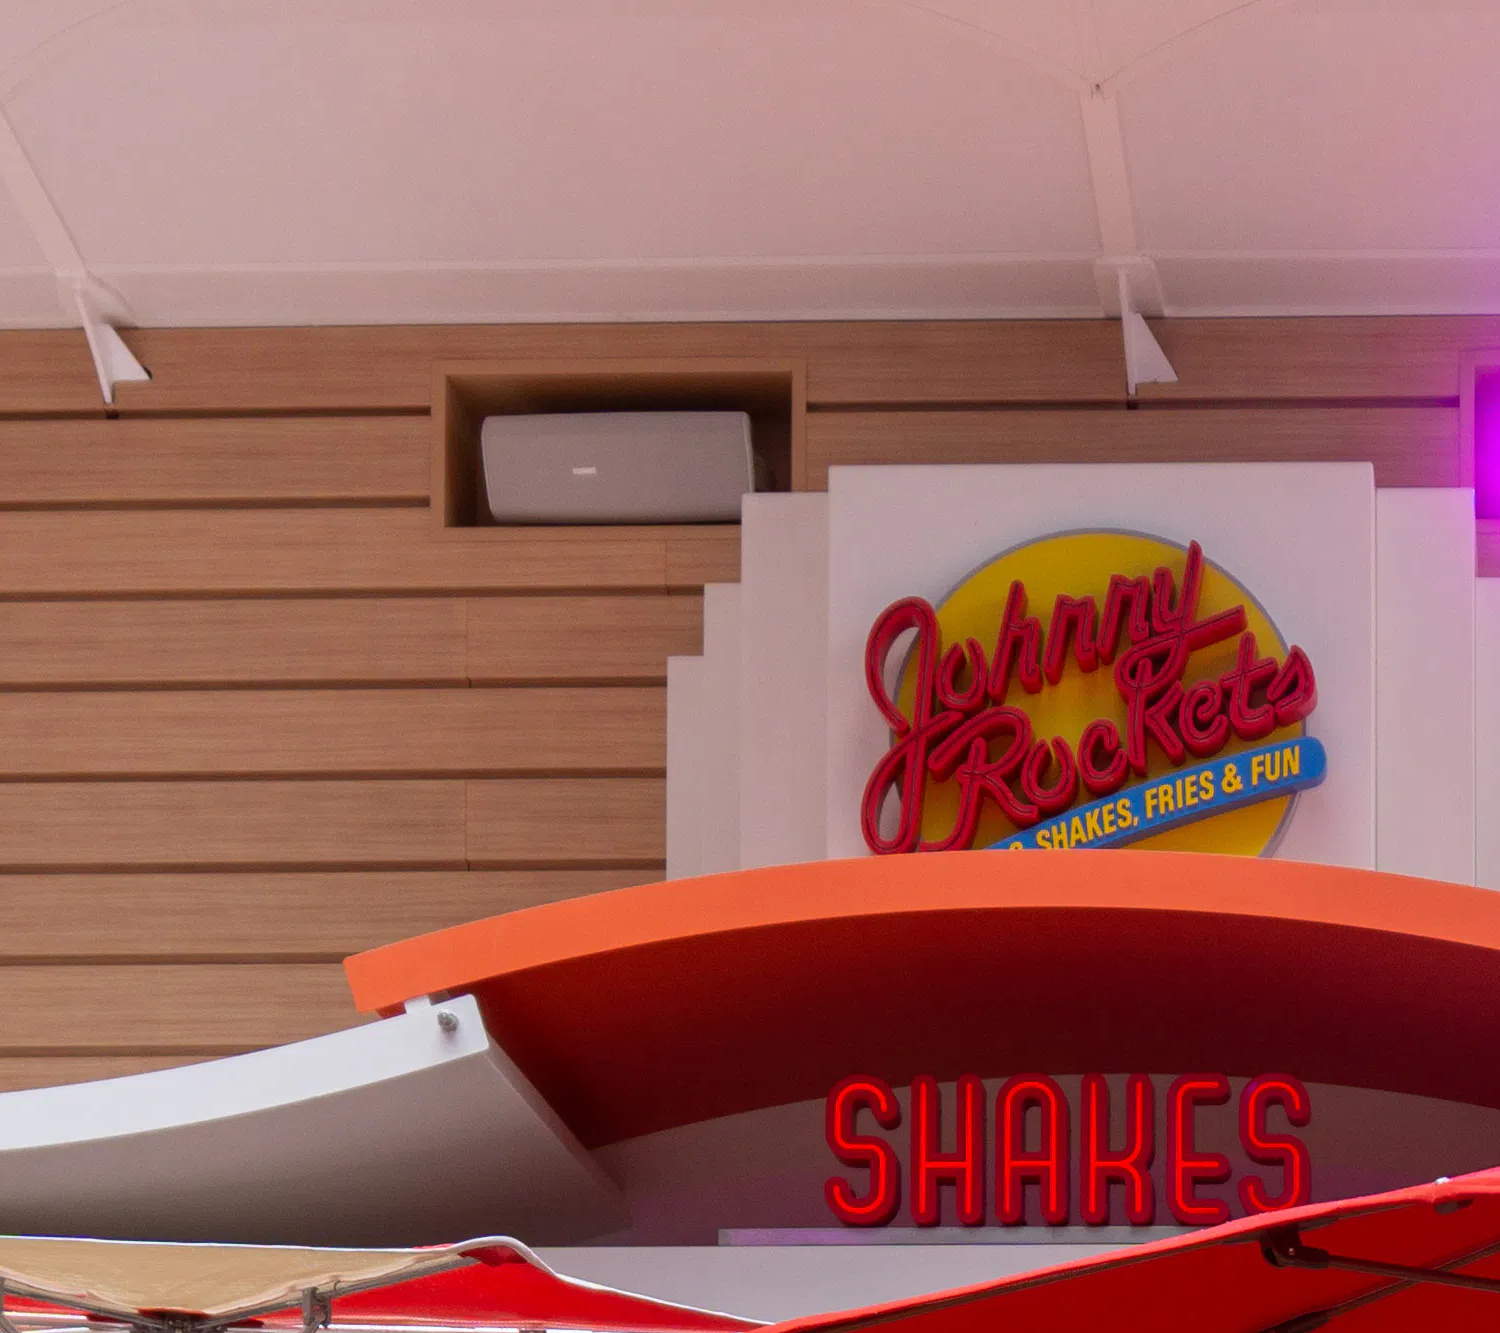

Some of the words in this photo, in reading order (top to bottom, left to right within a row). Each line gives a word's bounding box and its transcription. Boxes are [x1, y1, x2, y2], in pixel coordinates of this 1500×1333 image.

[861, 540, 1245, 855] Johnny
[917, 631, 1318, 853] Rockets
[1035, 797, 1139, 850] SHAKES,
[1145, 769, 1216, 820] FRIES
[1221, 762, 1244, 794] &
[1250, 746, 1302, 786] FUN
[824, 1073, 1311, 1227] SHAKES
